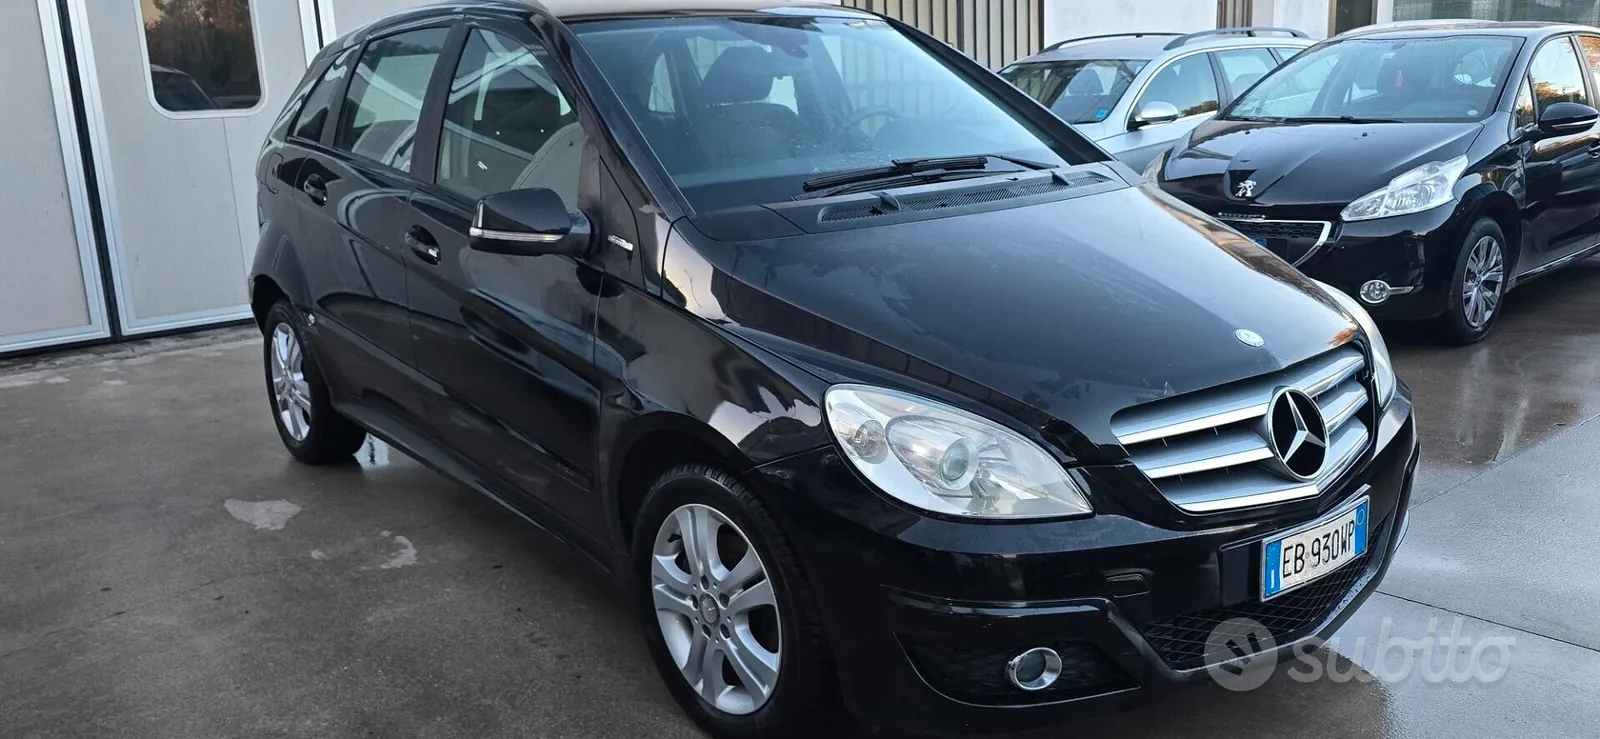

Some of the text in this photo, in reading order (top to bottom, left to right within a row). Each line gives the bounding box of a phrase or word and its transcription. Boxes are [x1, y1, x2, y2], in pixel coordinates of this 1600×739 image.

[1282, 519, 1355, 578] EB 930WP
[1270, 569, 1275, 589] I
